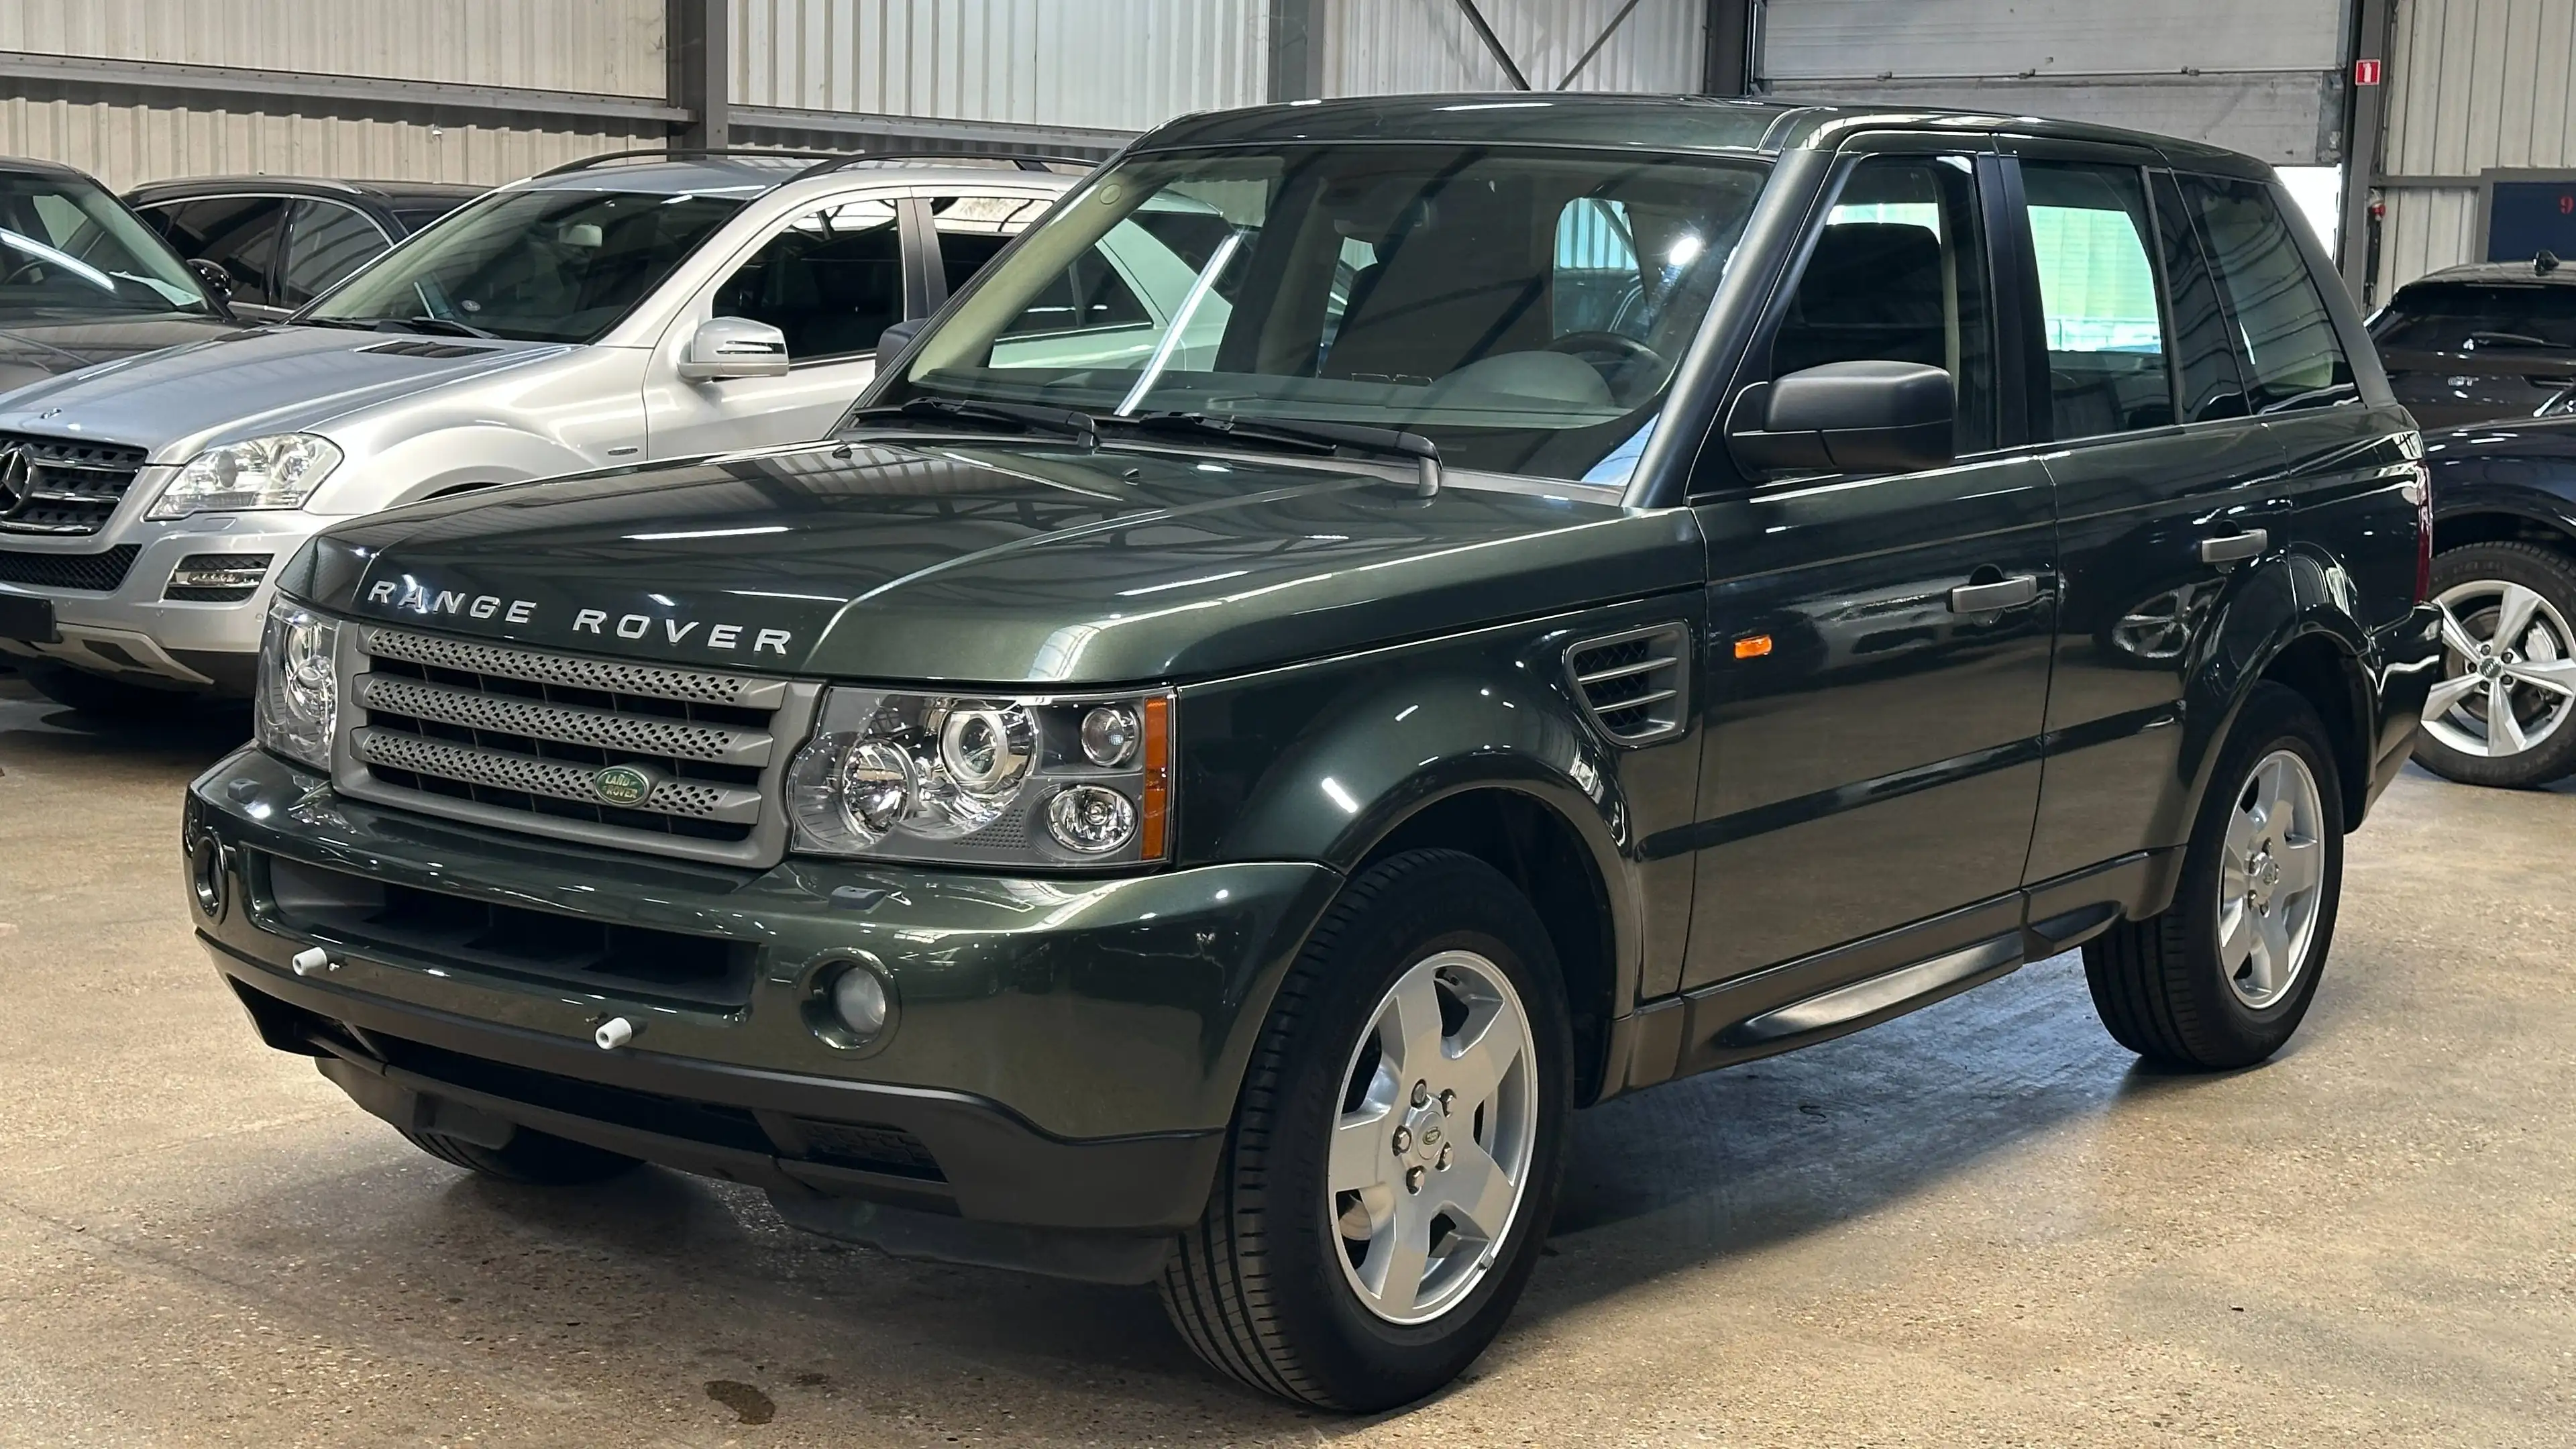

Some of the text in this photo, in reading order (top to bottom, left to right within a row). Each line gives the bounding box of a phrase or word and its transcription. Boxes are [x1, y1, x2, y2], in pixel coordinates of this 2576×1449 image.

[2560, 197, 2574, 215] 9
[368, 580, 792, 655] RANGE ROVER
[605, 773, 631, 787] LAND
[606, 785, 638, 799] ROVER
